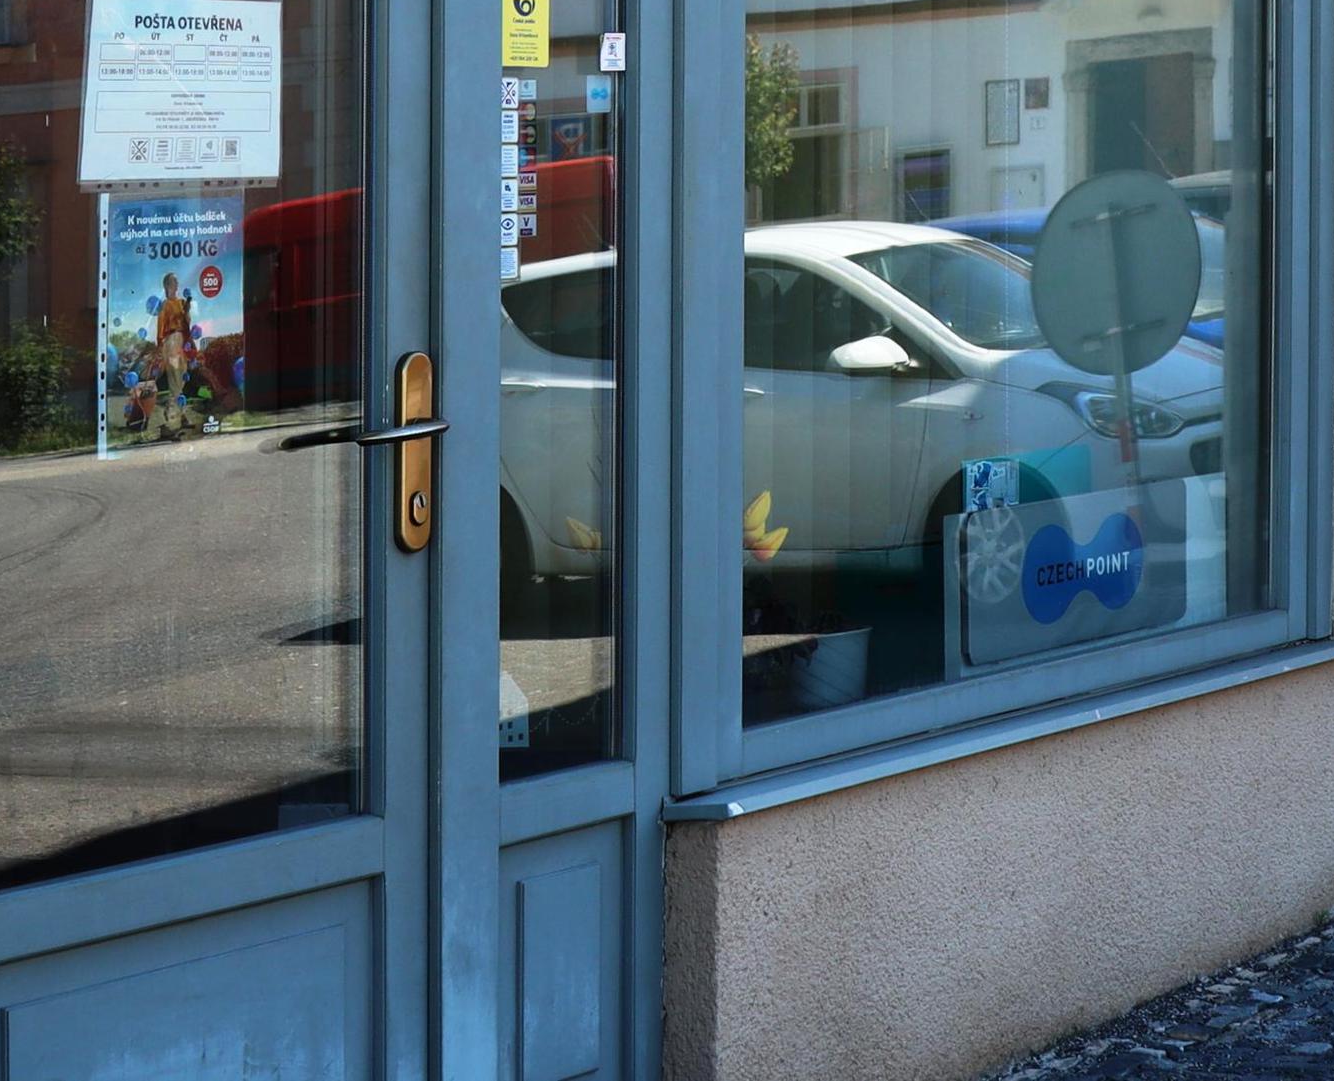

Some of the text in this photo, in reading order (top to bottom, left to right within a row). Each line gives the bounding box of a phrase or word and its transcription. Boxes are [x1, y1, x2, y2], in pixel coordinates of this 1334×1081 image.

[134, 13, 243, 31] POŠTA OTEVŘENA
[127, 210, 226, 226] K novému účtu balíček
[120, 229, 149, 241] výhod
[150, 230, 161, 238] na
[164, 227, 188, 239] cesty
[196, 223, 233, 235] hodnotě
[197, 239, 218, 257] Kč
[203, 278, 219, 286] 500
